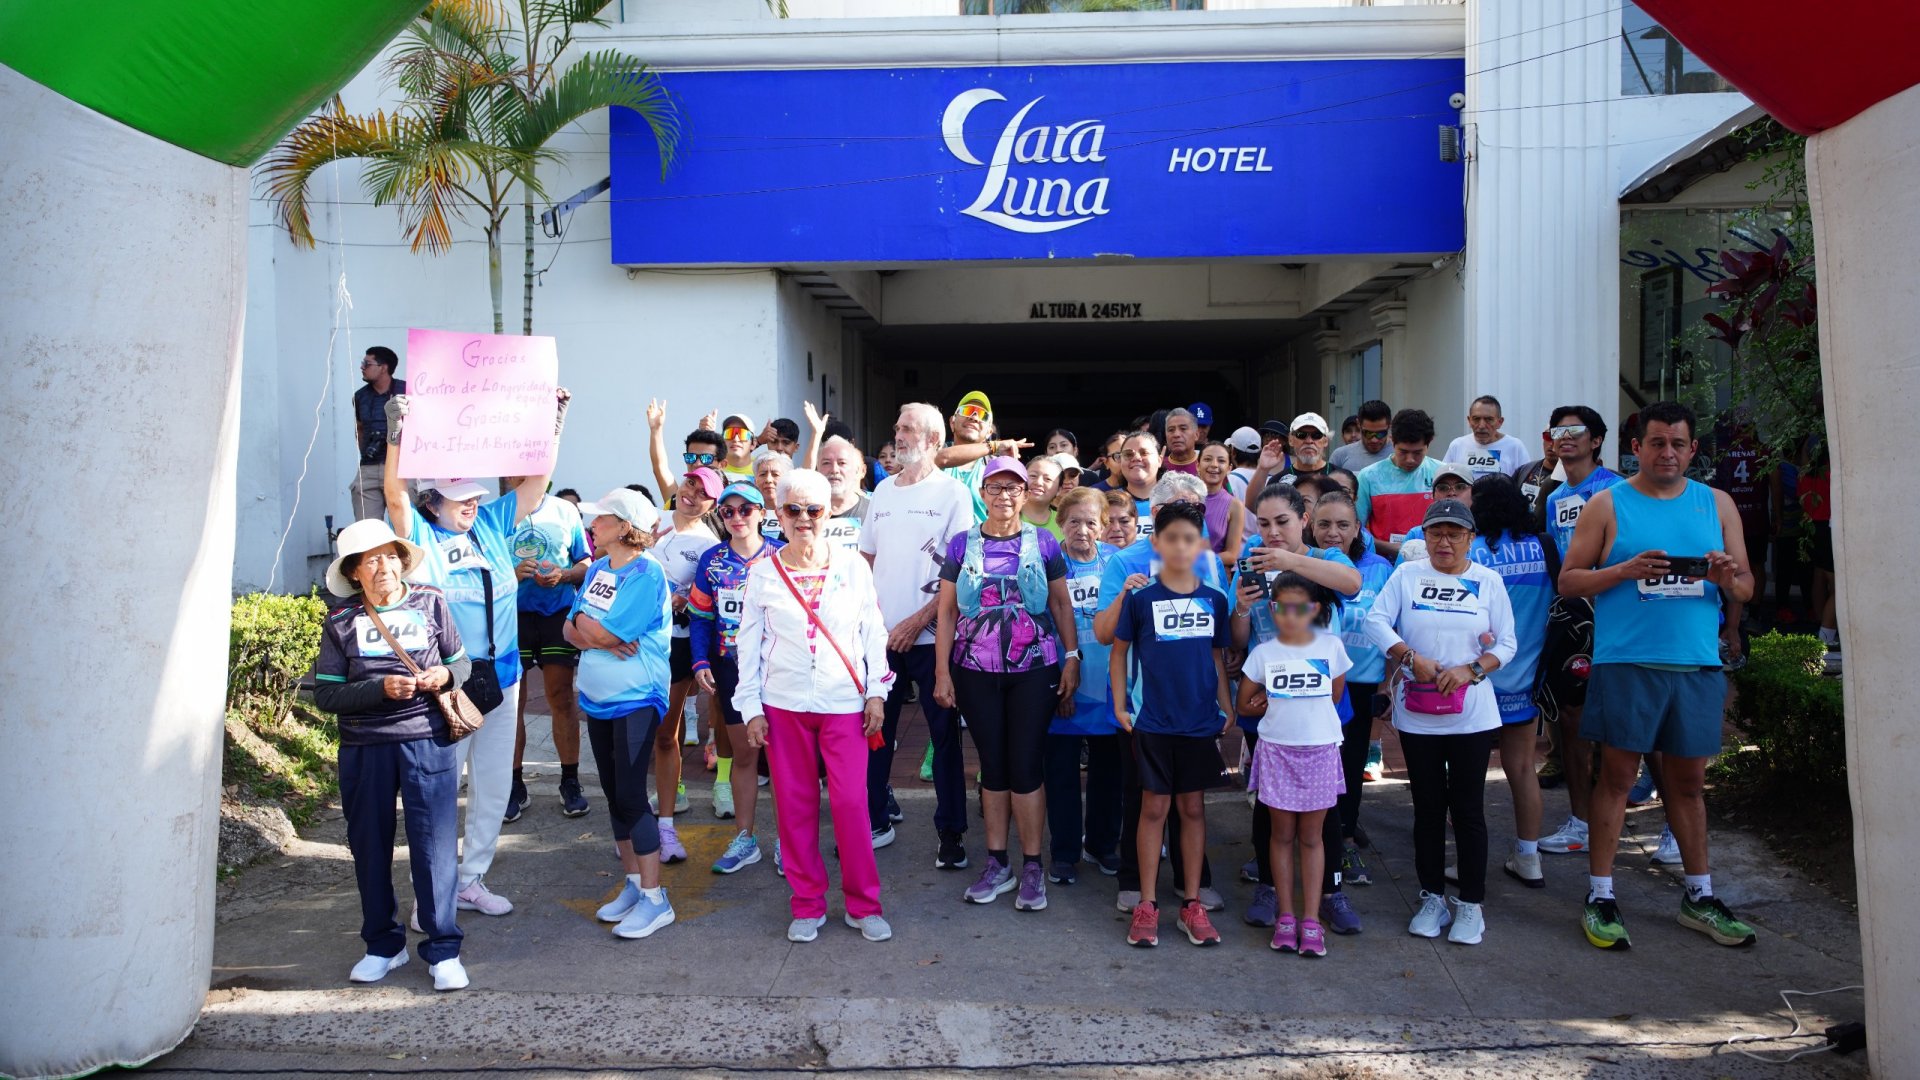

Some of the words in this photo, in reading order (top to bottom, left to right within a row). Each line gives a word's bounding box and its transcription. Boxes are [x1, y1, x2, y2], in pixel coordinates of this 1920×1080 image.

[1168, 147, 1273, 172] HOTEL
[960, 160, 1110, 233] Luna
[1029, 303, 1088, 319] ALTURA
[462, 340, 527, 368] Gracias
[414, 371, 456, 396] Centro
[461, 380, 477, 393] de
[456, 404, 521, 428] Gracias
[1467, 456, 1496, 466] 045
[1734, 460, 1750, 483] 4
[1475, 542, 1545, 567] CENTR
[589, 582, 617, 599] 005
[1421, 587, 1472, 602] 027
[1163, 612, 1210, 629] 055
[366, 623, 418, 643] 044
[1272, 673, 1322, 689] 053
